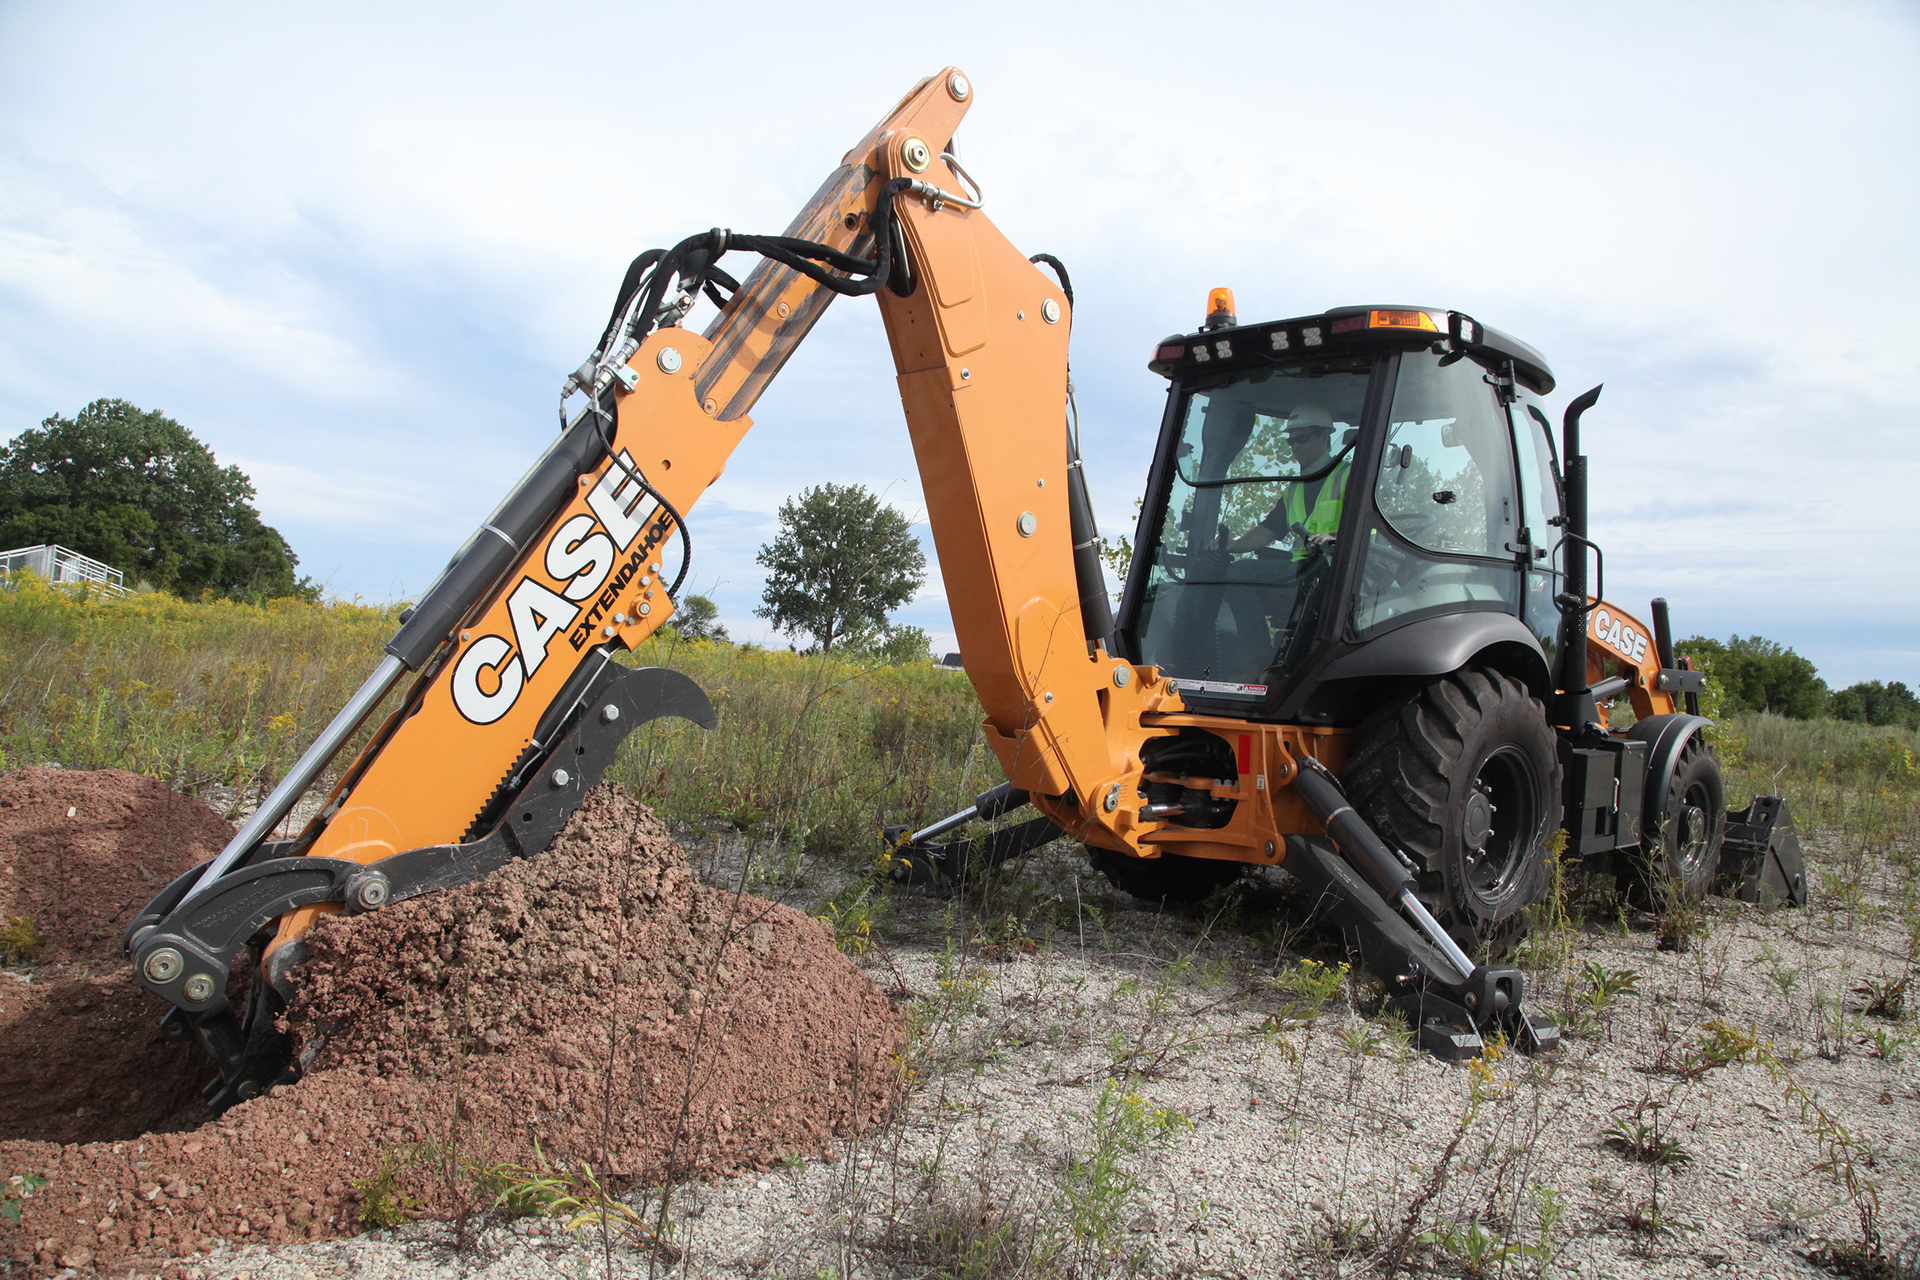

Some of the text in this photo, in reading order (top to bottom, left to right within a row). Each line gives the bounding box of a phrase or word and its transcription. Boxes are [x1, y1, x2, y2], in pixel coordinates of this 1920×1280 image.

[451, 446, 660, 725] CASE
[568, 509, 674, 652] EXTENDAHOE
[1595, 609, 1648, 664] CASE
